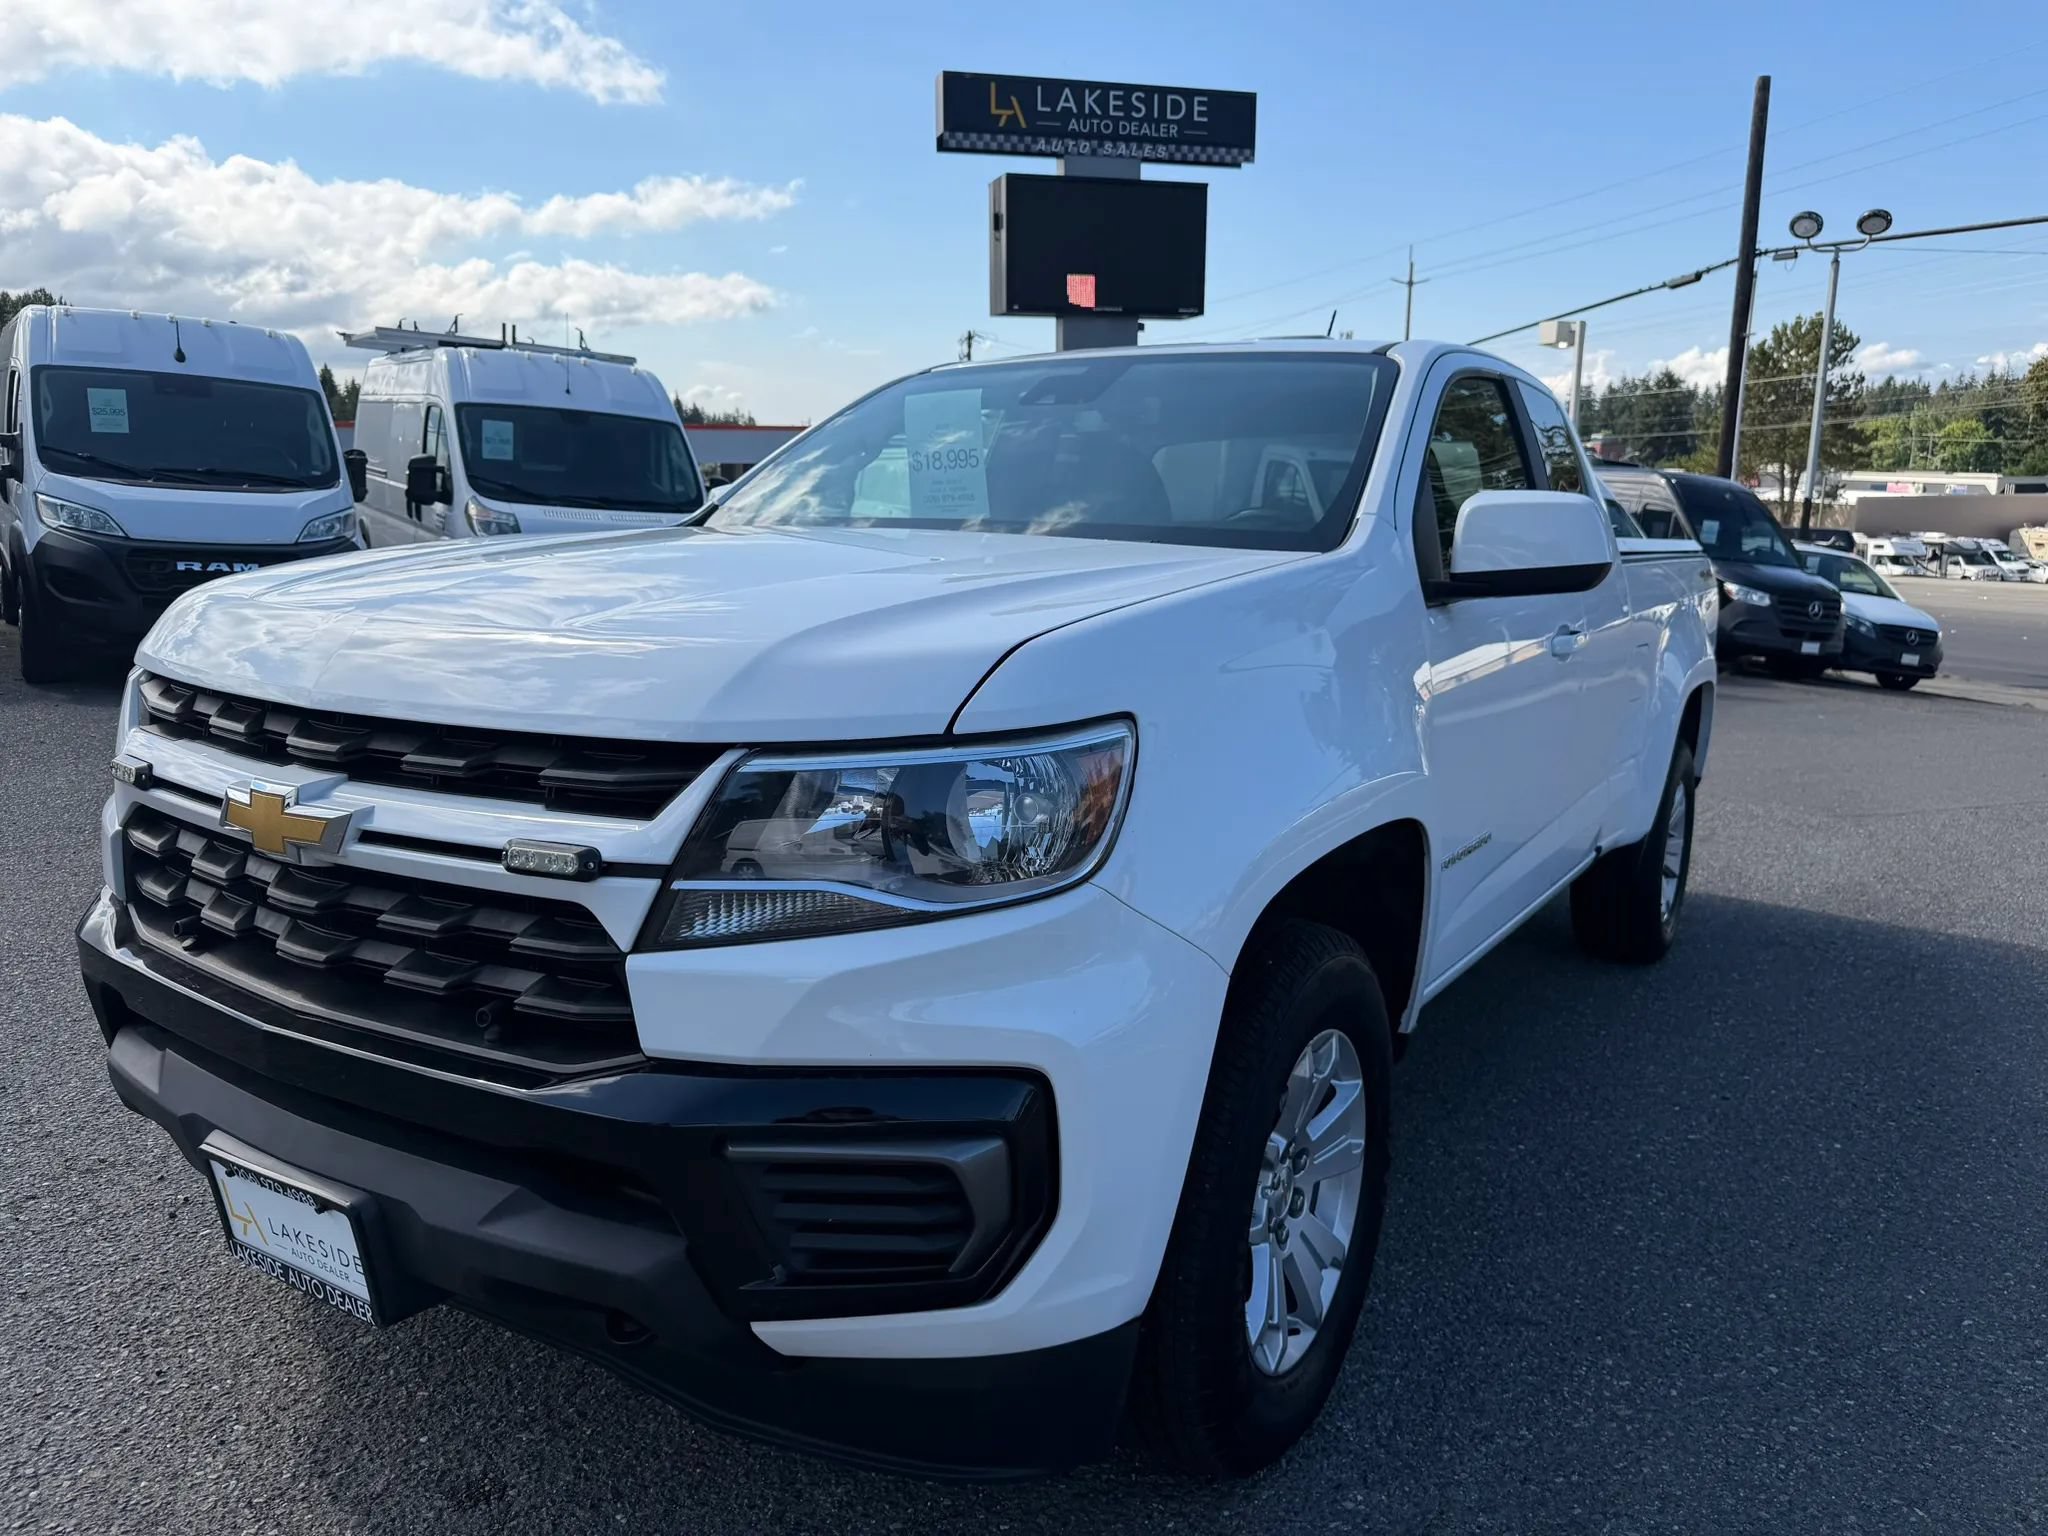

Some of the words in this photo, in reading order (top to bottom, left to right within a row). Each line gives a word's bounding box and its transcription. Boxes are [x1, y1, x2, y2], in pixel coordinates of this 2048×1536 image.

[1036, 85, 1209, 122] LAKESIDE
[1067, 118, 1113, 134] AUTO
[1119, 121, 1178, 138] DEALER
[1035, 139, 1091, 154] AUTO
[1103, 142, 1168, 158] SALES
[911, 448, 980, 474] $18,995
[176, 561, 260, 573] RAM
[267, 1217, 365, 1276] LAKESIDE
[291, 1247, 315, 1266] AUTO
[316, 1258, 351, 1283] DEALER
[229, 1240, 285, 1282] LAKESIDE
[288, 1268, 325, 1300] AUTO
[326, 1285, 376, 1326] DEALER
